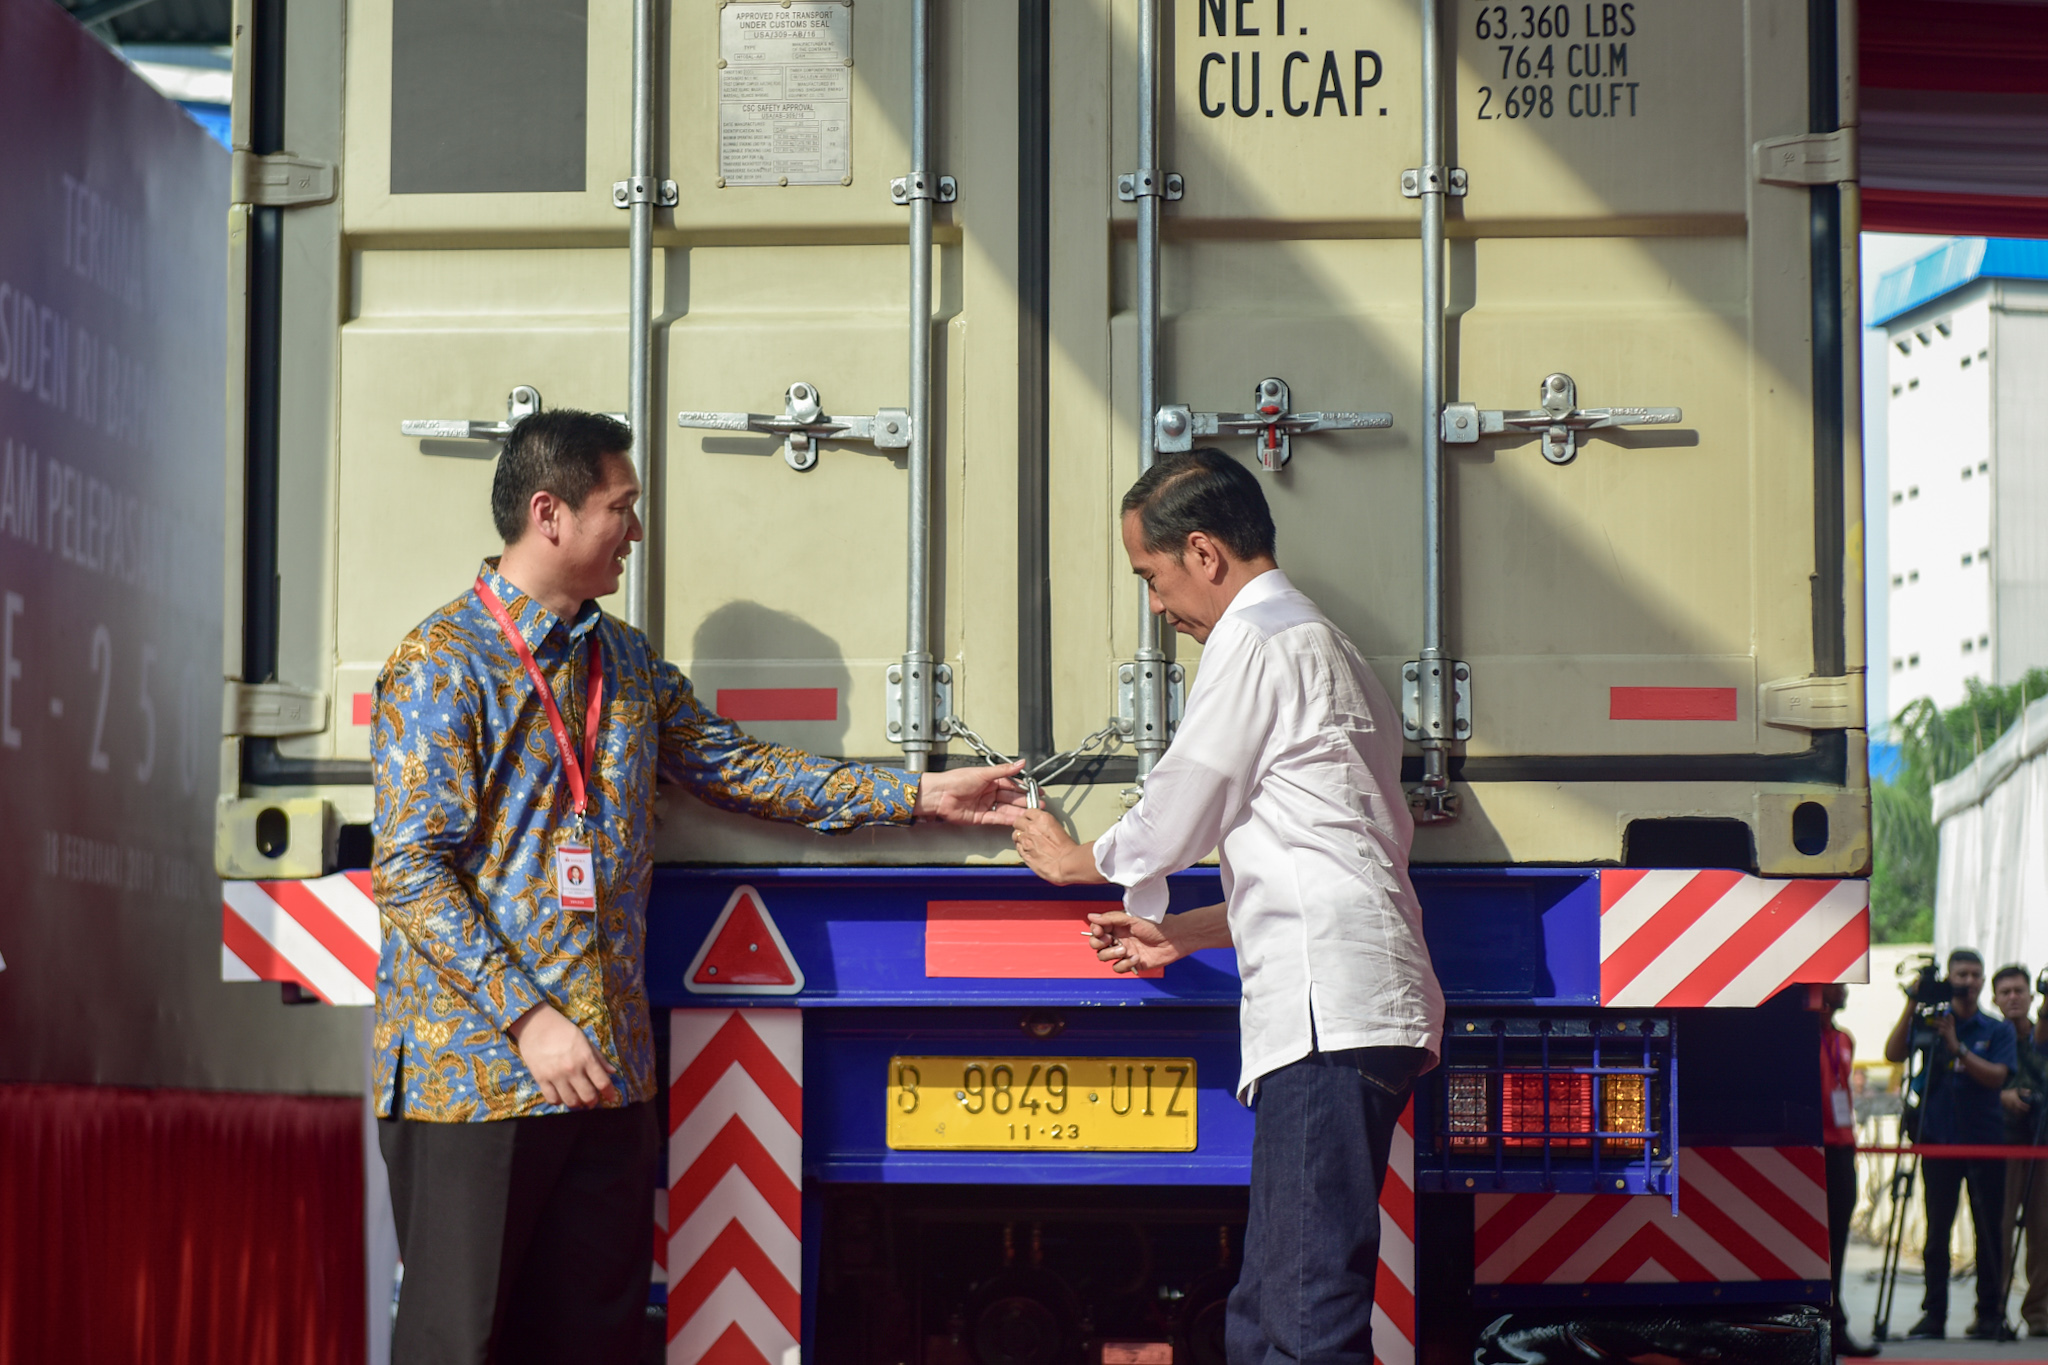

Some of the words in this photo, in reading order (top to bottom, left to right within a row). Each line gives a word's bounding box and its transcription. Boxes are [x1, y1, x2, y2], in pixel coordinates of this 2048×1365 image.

[736, 12, 774, 20] APPROVED
[776, 12, 790, 20] FOR
[792, 11, 834, 19] TRANSPORT
[740, 21, 767, 29] UNDER
[769, 20, 807, 28] CUSTOMS
[811, 20, 830, 28] SEAL
[1476, 4, 1570, 40] 63,360
[1586, 2, 1636, 38] LBS
[1498, 43, 1554, 79] 76.4
[1568, 42, 1628, 78] CU.M
[1199, 50, 1388, 118] CU.CAP.
[1477, 84, 1554, 120] 2,698
[1568, 82, 1640, 118] CU.FT
[742, 104, 755, 112] CSC
[757, 104, 780, 112] SAFETY
[496, 609, 518, 640] MAYORA
[530, 666, 549, 700] MAYORA
[557, 730, 574, 766] MAYORA
[898, 1064, 920, 1115] B
[963, 1064, 1068, 1115] 9849
[1110, 1065, 1190, 1117] UIZ
